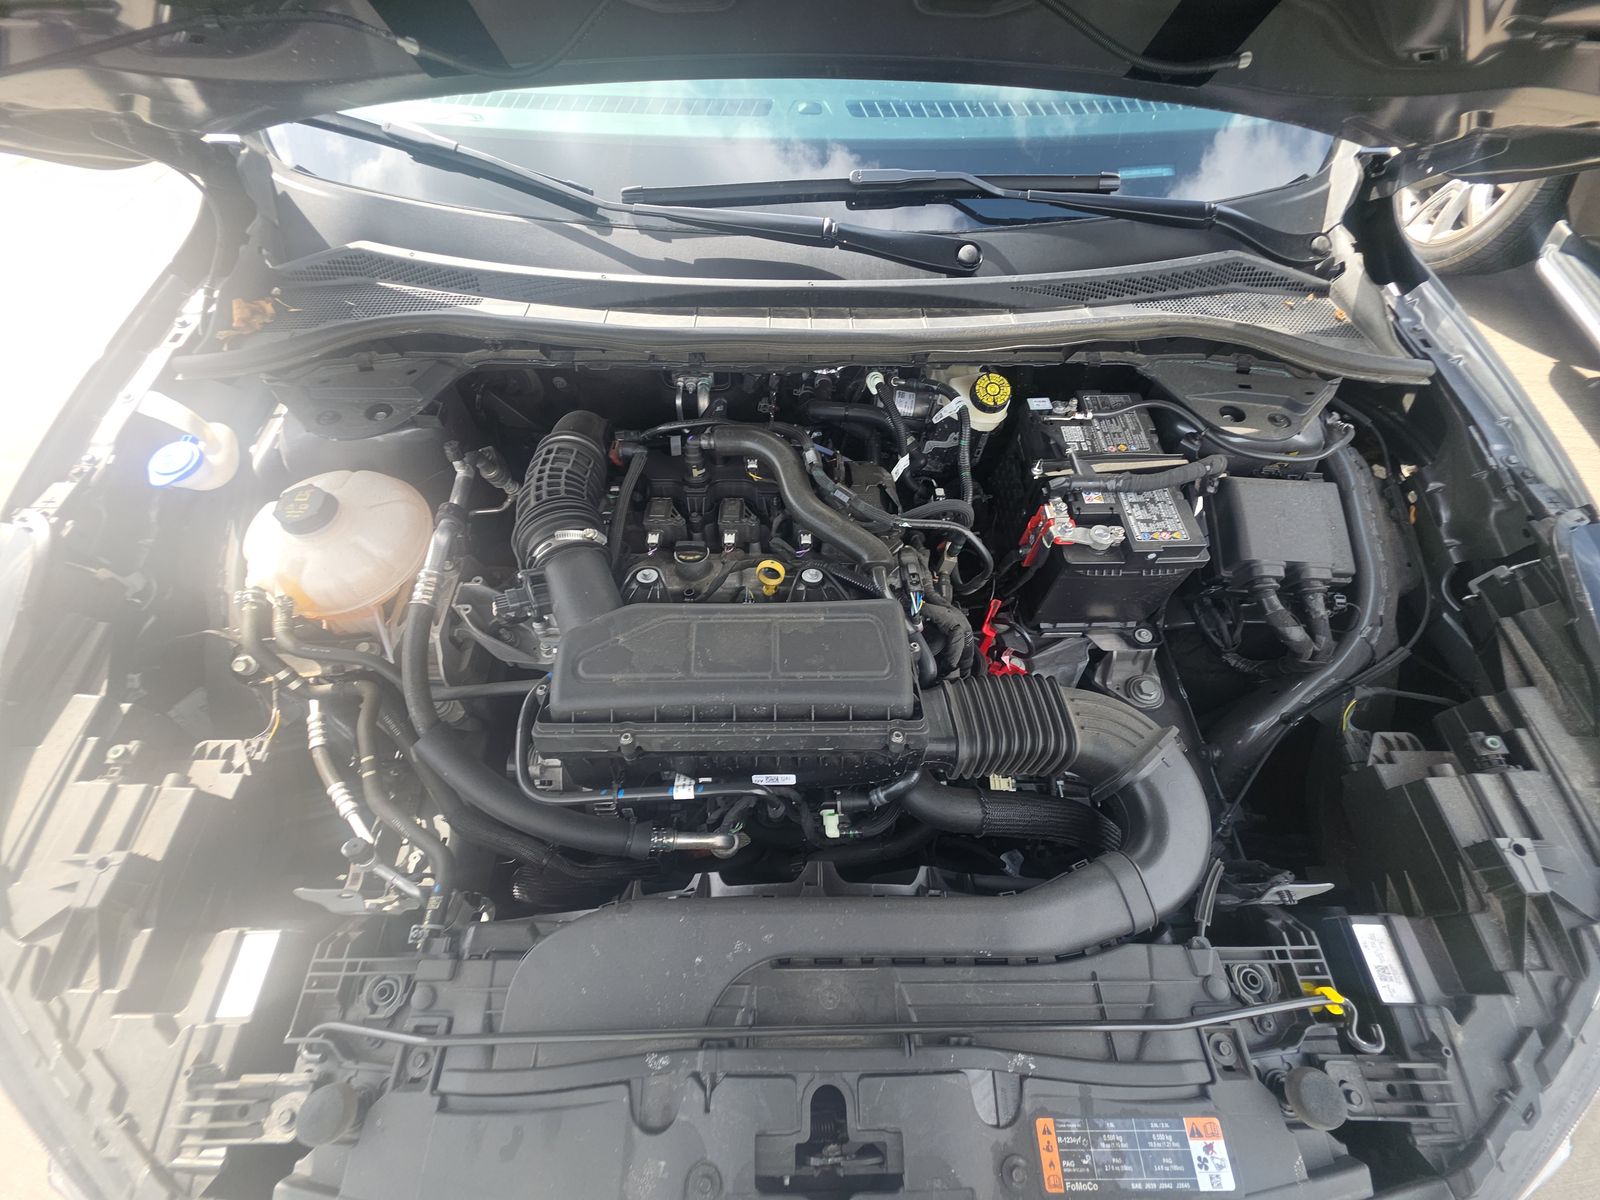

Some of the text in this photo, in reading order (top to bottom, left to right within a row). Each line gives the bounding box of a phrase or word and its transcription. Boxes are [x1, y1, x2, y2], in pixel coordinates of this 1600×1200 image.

[1057, 1136, 1081, 1145] R-1234yf
[1115, 1134, 1123, 1143] kg
[1165, 1133, 1173, 1142] kg
[1062, 1160, 1076, 1168] PAG
[1065, 1181, 1099, 1192] FoMoCo
